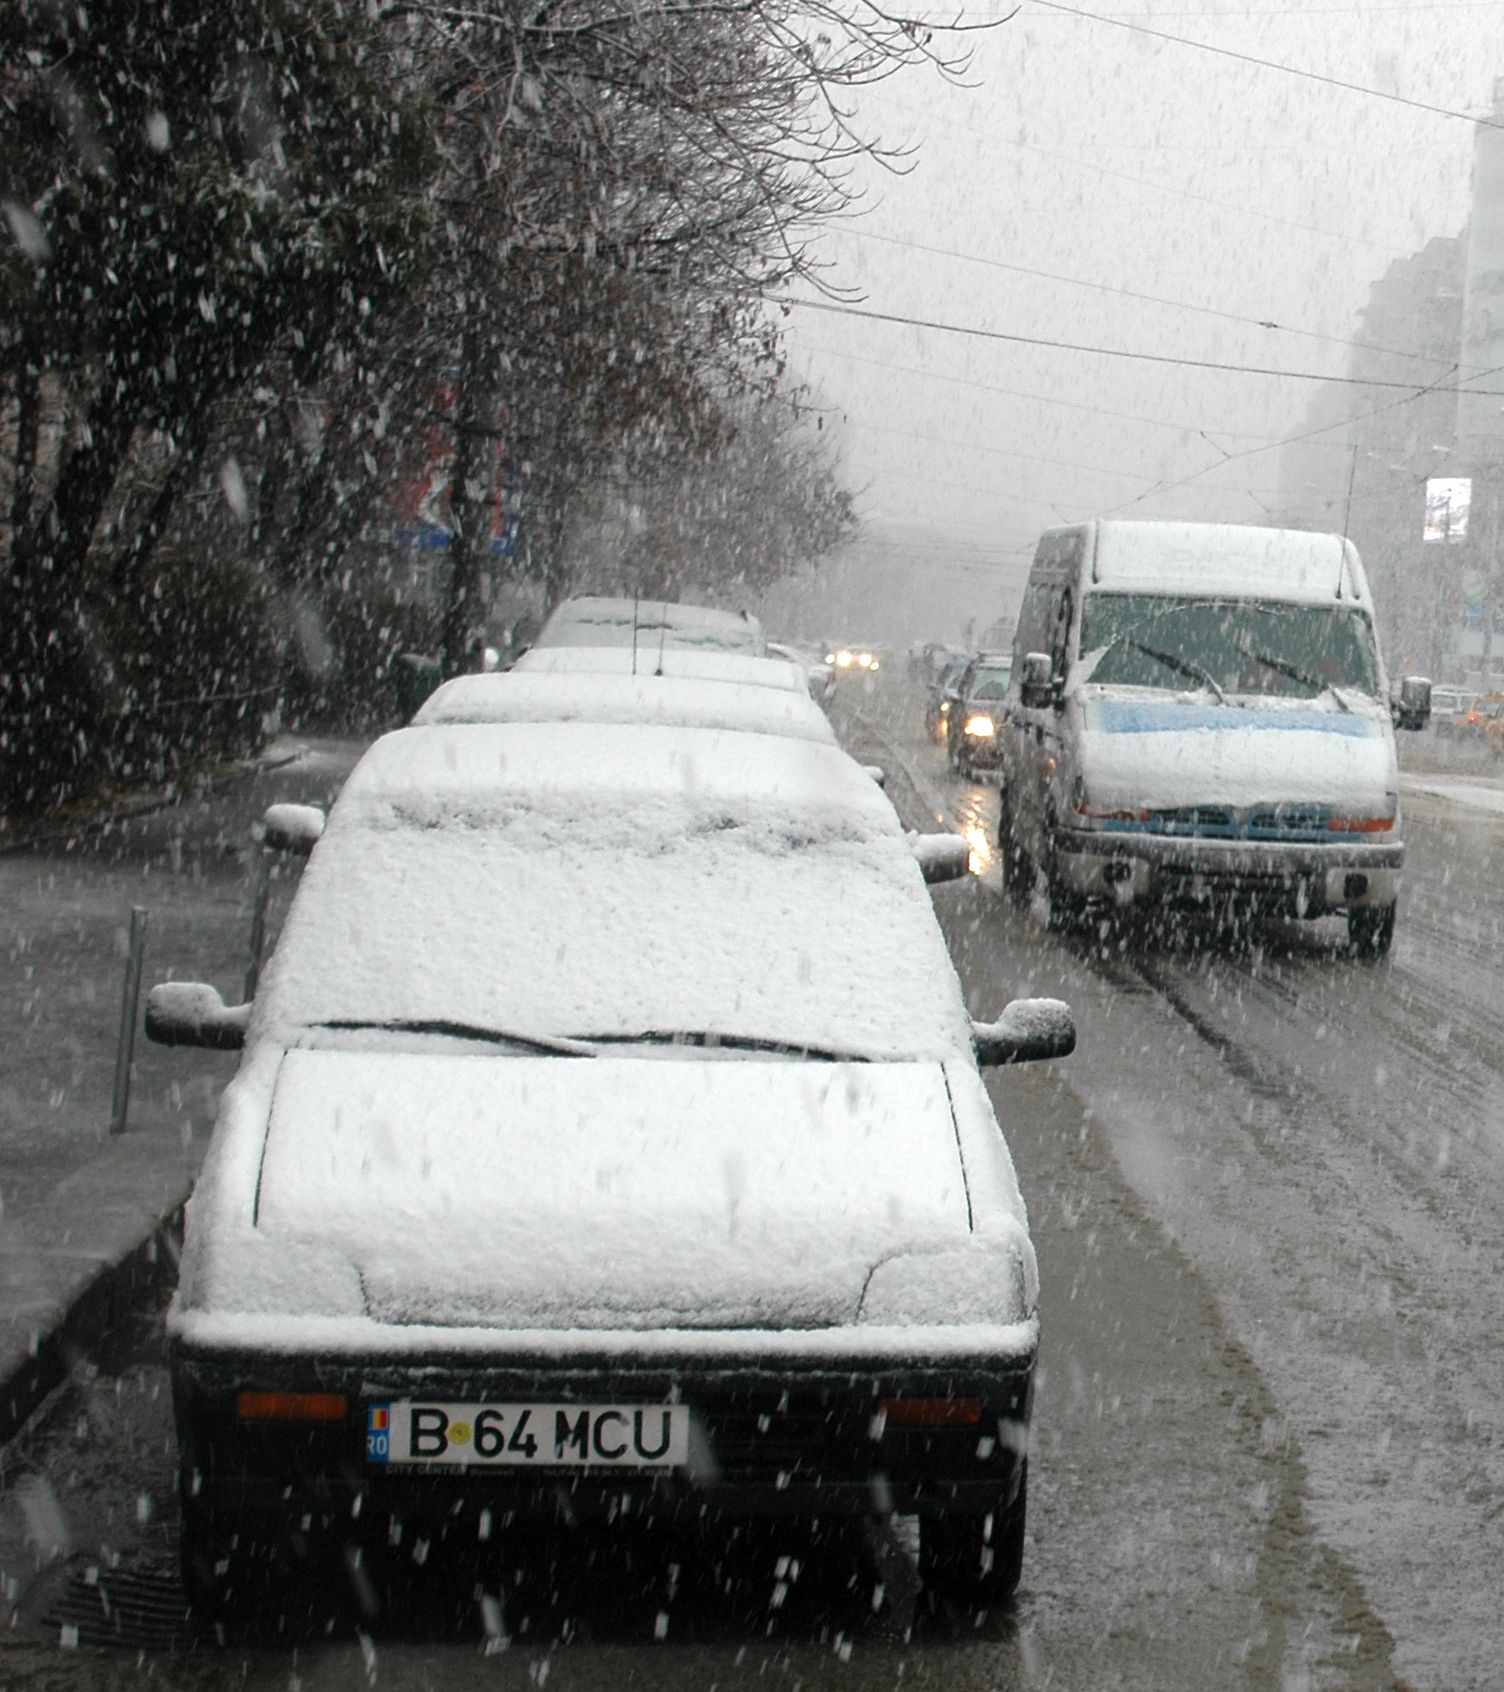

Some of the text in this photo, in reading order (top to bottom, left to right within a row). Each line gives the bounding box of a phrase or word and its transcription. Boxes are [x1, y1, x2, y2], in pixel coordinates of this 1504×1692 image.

[367, 1436, 388, 1455] RO
[410, 1408, 671, 1460] B 64 MCU
